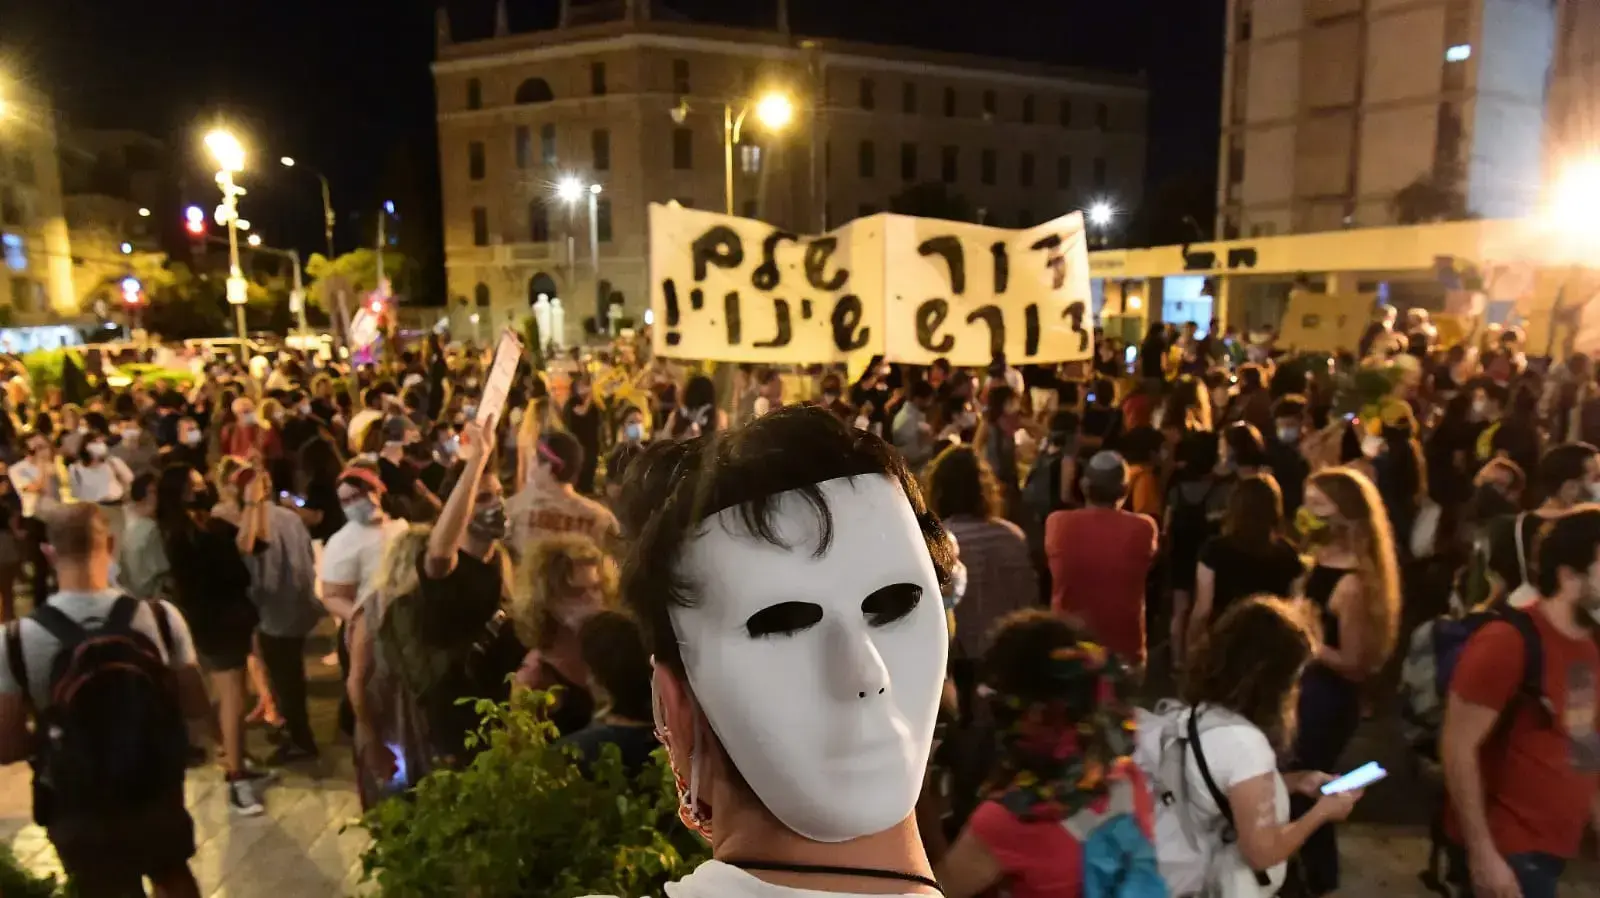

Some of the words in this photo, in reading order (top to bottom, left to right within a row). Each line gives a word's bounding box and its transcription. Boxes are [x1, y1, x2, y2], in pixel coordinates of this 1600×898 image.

[691, 225, 849, 291] שלם
[917, 233, 1066, 296] דור
[662, 278, 870, 352] שינוי!
[916, 298, 1089, 361] דורש
